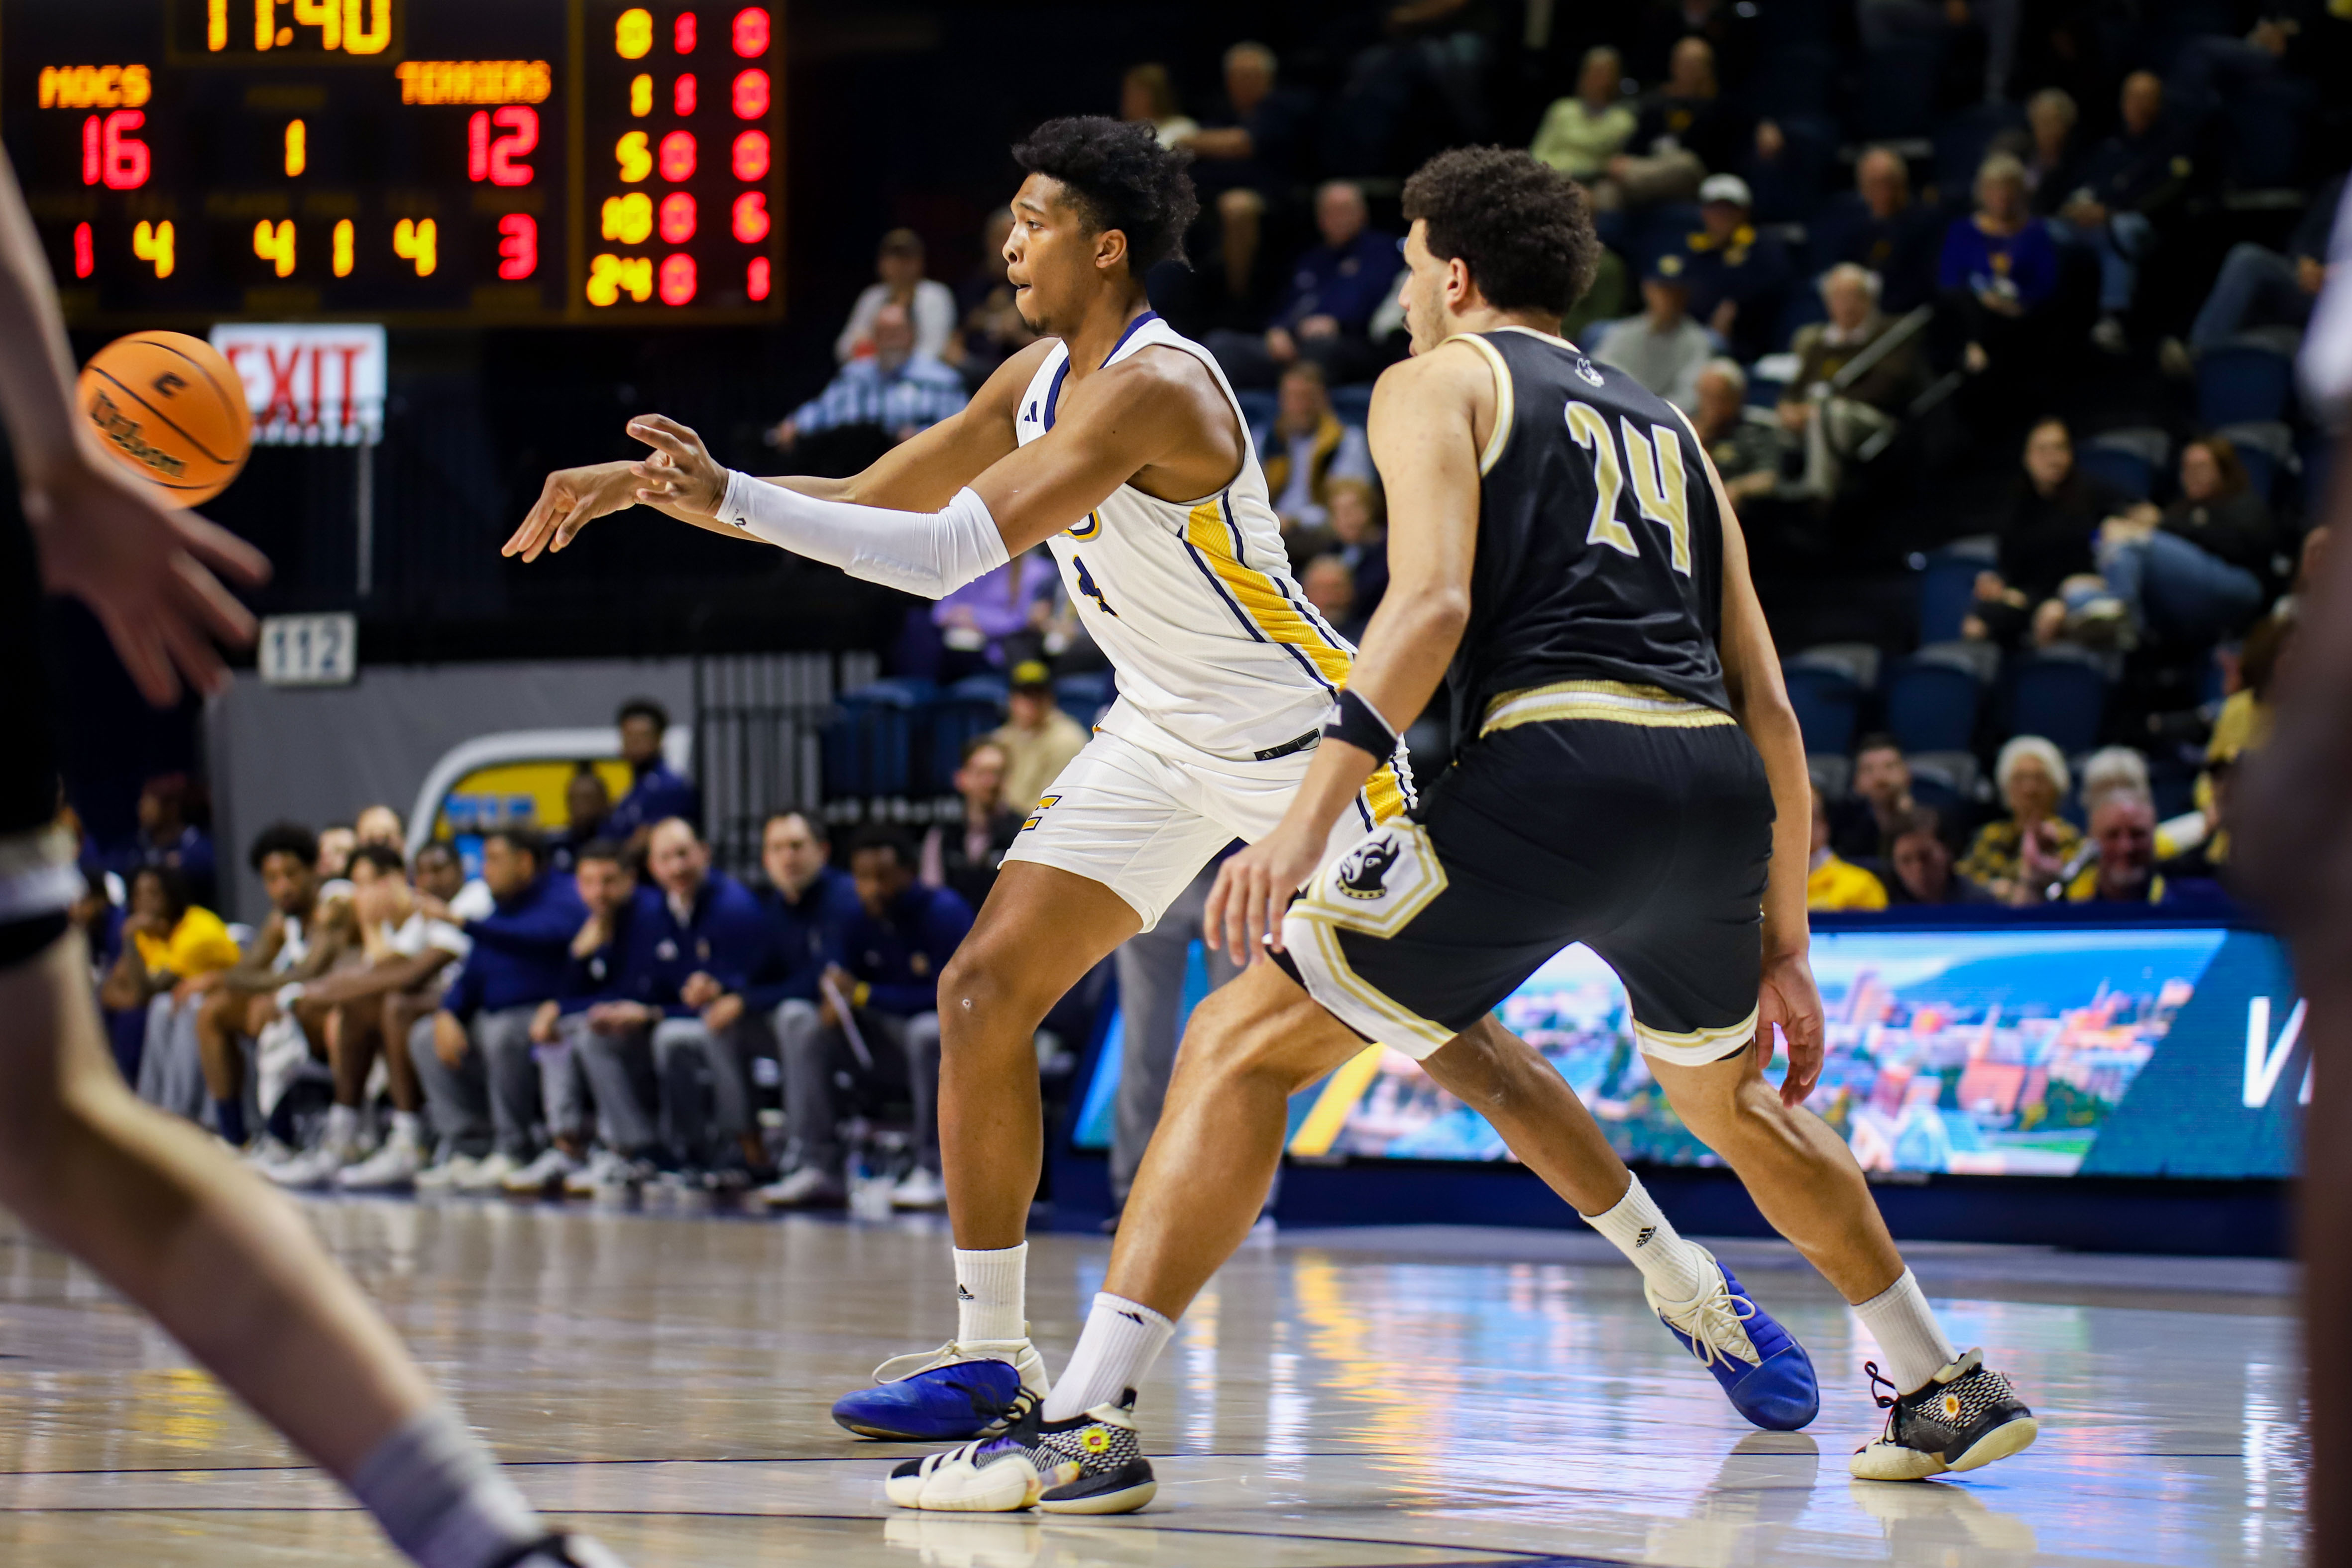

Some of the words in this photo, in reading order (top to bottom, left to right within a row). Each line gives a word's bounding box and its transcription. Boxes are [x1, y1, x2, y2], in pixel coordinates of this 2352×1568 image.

[674, 12, 697, 55] 1
[38, 64, 151, 109] MOCS
[631, 73, 653, 117] 1
[674, 73, 697, 116] 1
[83, 110, 150, 190] 16
[285, 119, 306, 177] 1
[468, 106, 539, 186] 12
[616, 131, 653, 183] 5
[732, 191, 771, 243] 6
[74, 222, 94, 279] 1
[133, 220, 174, 279] 4
[253, 220, 296, 278] 4
[333, 219, 354, 278] 1
[394, 219, 437, 277] 4
[499, 214, 537, 280] 3
[748, 256, 771, 301] 1
[1564, 401, 1691, 578] 24
[274, 617, 342, 670] 112
[1636, 1225, 1657, 1247] adidas
